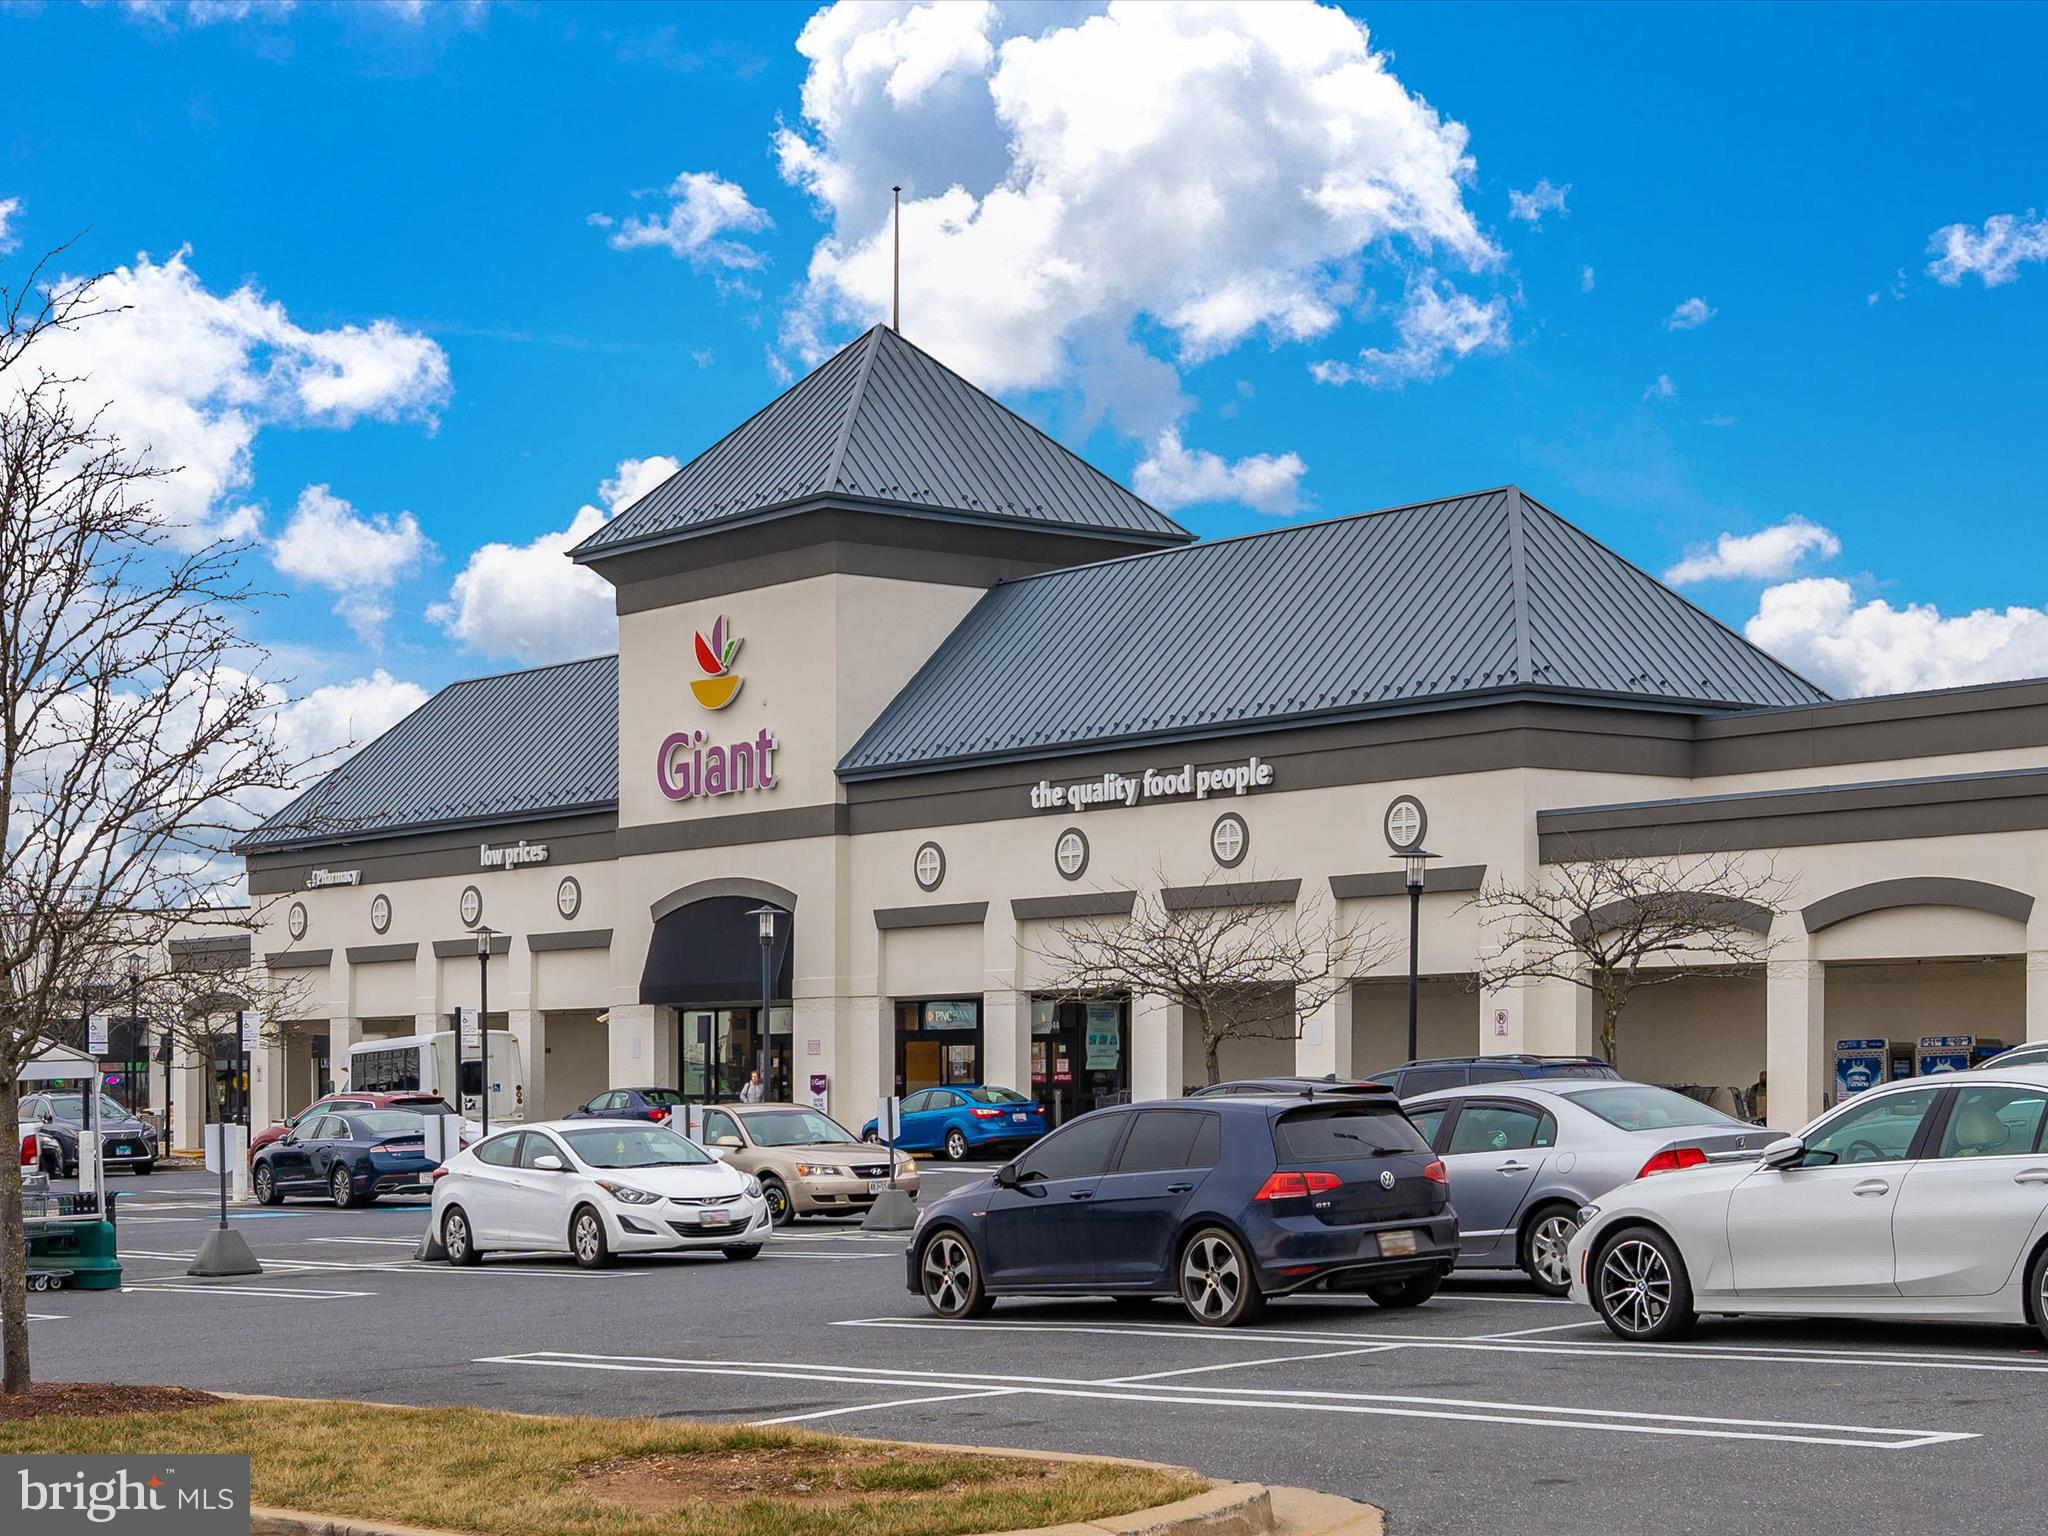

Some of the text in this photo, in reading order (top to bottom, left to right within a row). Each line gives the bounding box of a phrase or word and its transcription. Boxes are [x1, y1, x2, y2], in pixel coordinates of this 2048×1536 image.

[656, 727, 779, 802] Giant
[1030, 756, 1274, 811] the quality food people
[480, 840, 549, 869] low prices
